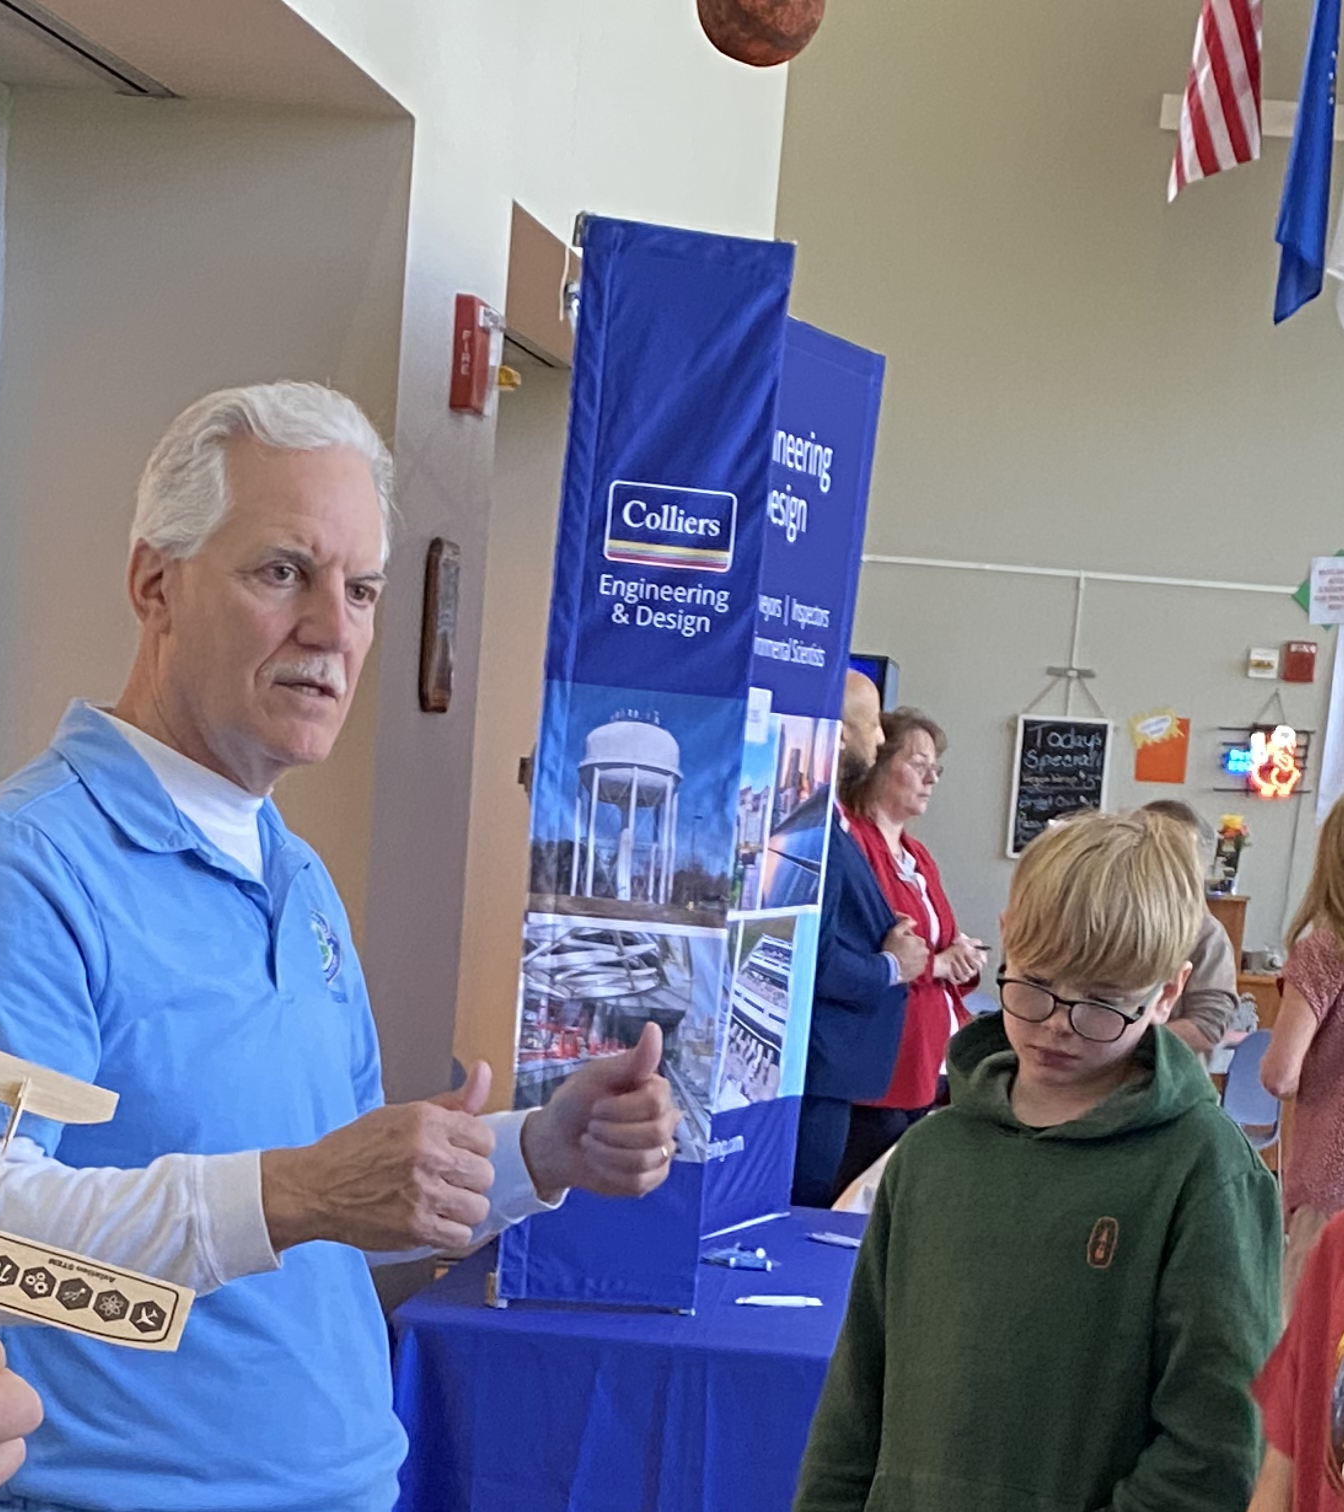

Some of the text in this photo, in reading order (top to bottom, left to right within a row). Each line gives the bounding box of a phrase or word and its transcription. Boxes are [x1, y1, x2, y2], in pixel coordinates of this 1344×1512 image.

[460, 329, 472, 376] FIRE
[622, 500, 721, 537] Colliers
[767, 483, 808, 543] esign
[599, 574, 730, 613] Engineering
[611, 603, 710, 637] & Design
[48, 1258, 116, 1283] Aviation STEM
